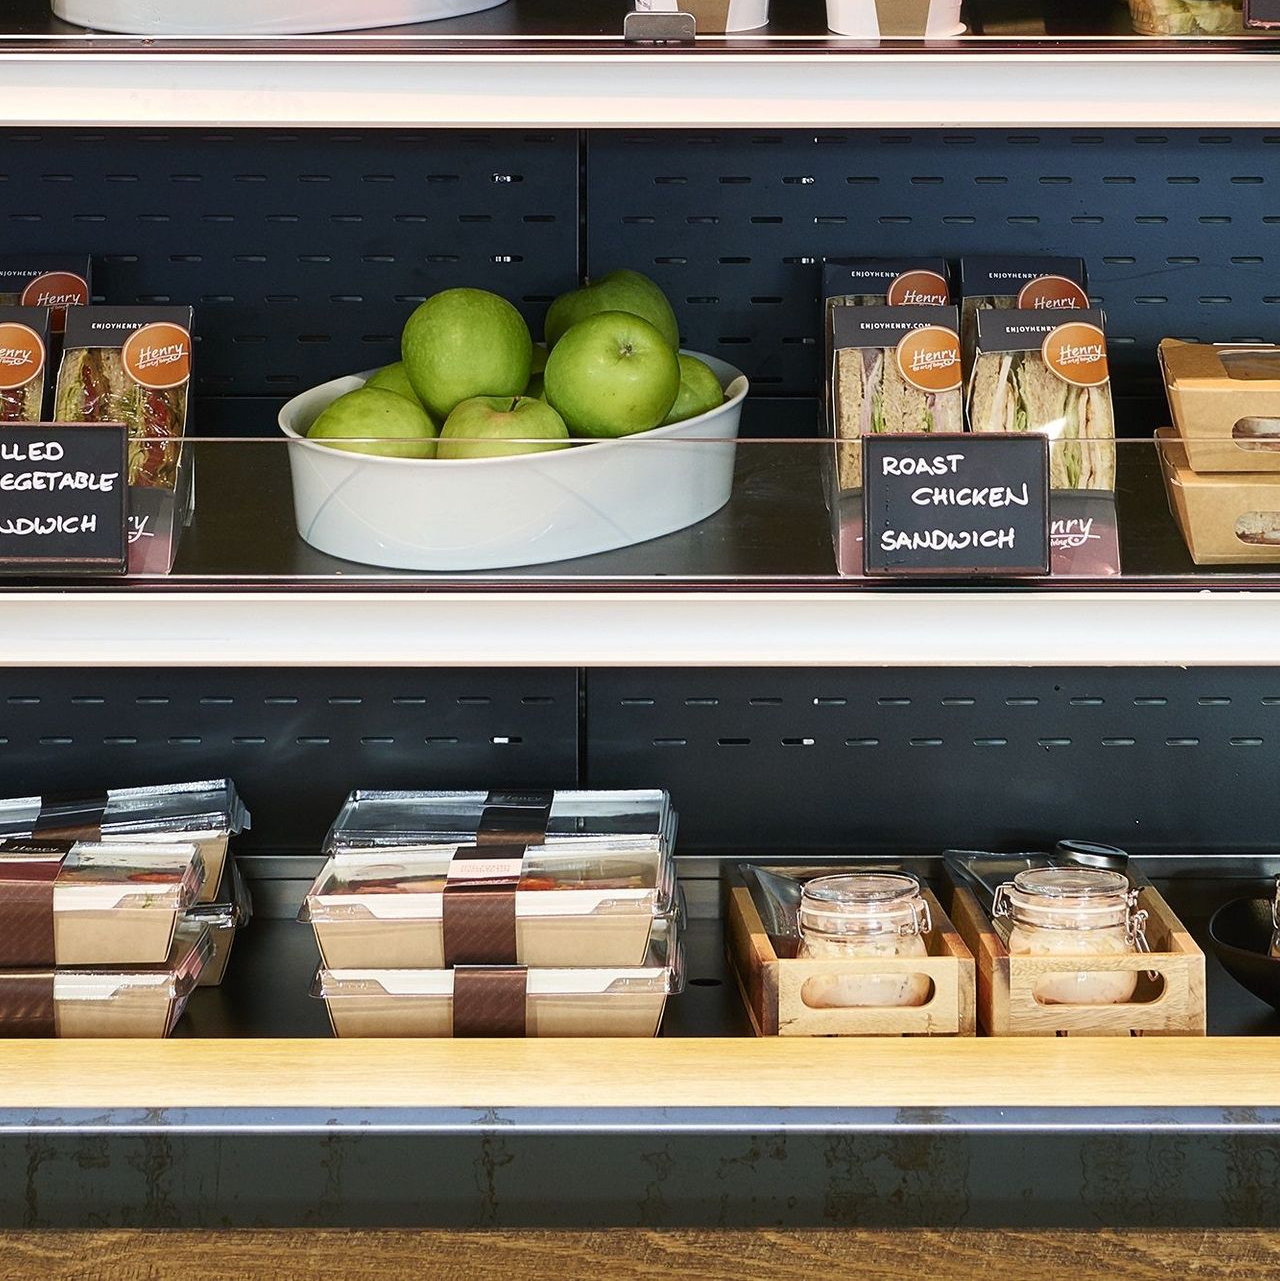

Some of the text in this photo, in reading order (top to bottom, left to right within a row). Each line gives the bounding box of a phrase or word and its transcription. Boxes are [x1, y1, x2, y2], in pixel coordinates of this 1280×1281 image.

[36, 291, 81, 306] Henry
[903, 289, 947, 305] Henry
[1033, 296, 1076, 309] Henry
[139, 343, 184, 364] Henry
[912, 348, 957, 367] Henry
[1059, 344, 1102, 362] Henry
[881, 453, 965, 477] ROAST
[910, 482, 1029, 507] CHICKEN
[879, 527, 1016, 551] SANDWICH
